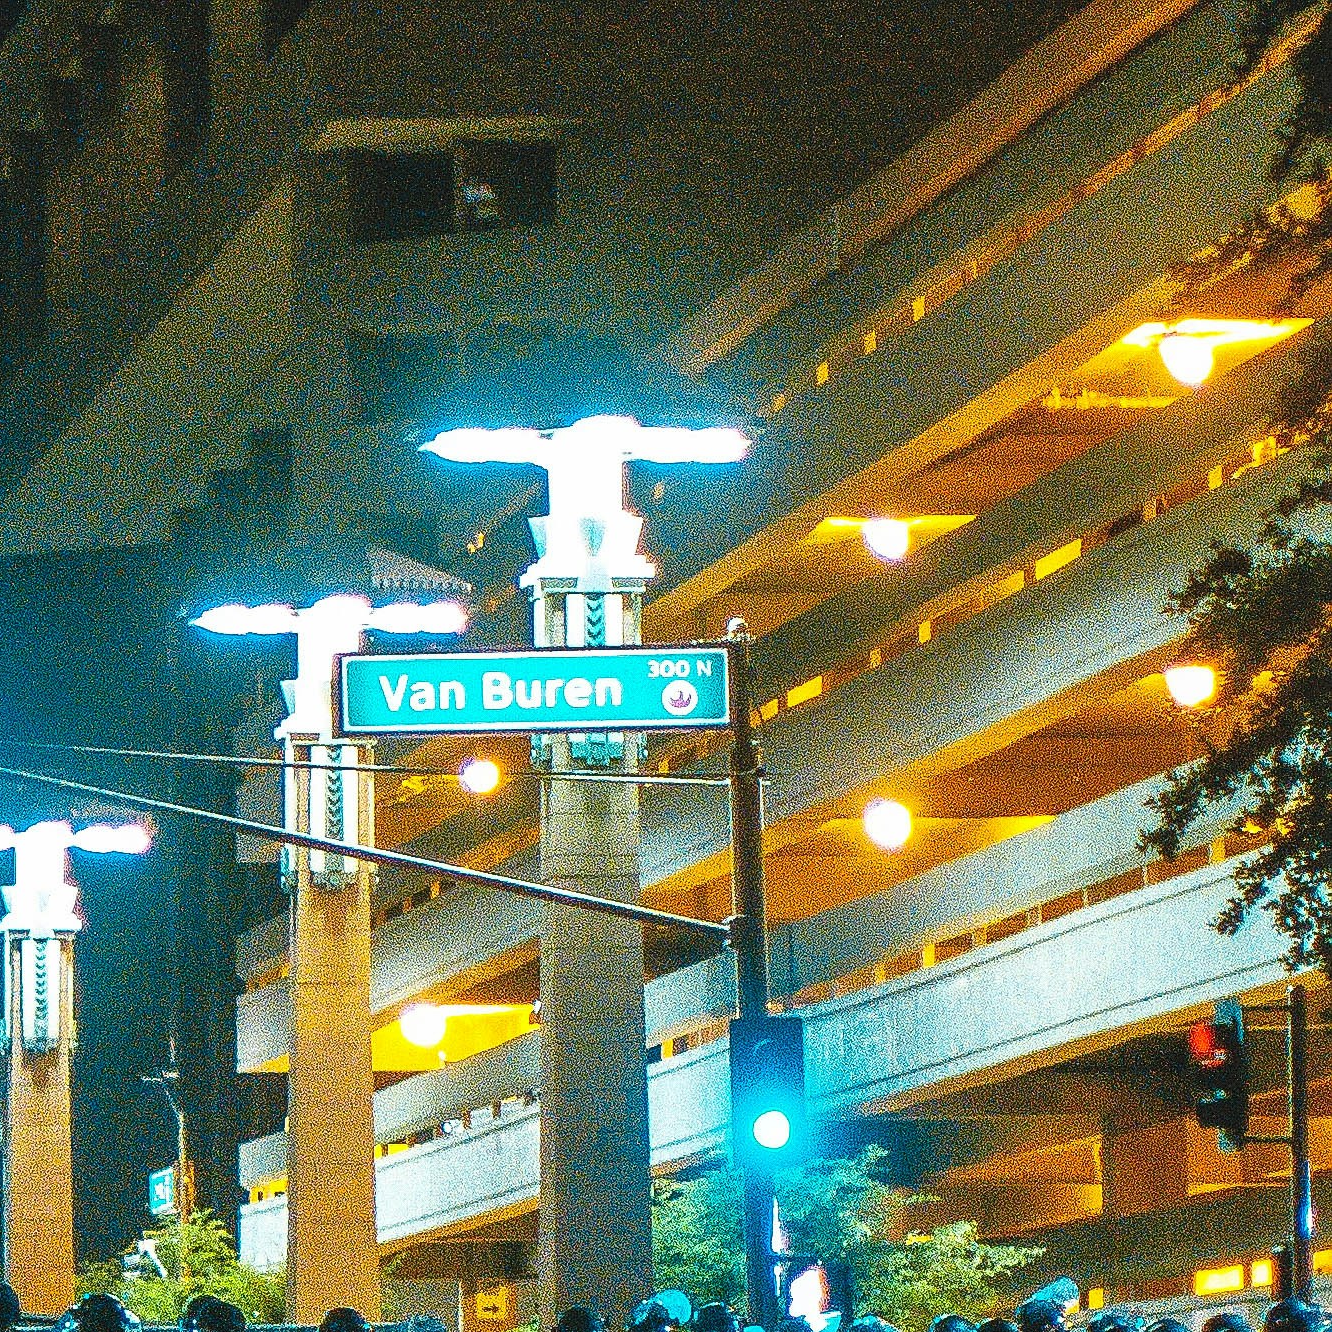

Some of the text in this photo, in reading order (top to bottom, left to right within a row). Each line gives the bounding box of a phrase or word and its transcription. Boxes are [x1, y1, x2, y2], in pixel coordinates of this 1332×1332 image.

[647, 659, 713, 678] 300 N
[378, 671, 623, 712] Van Buren
